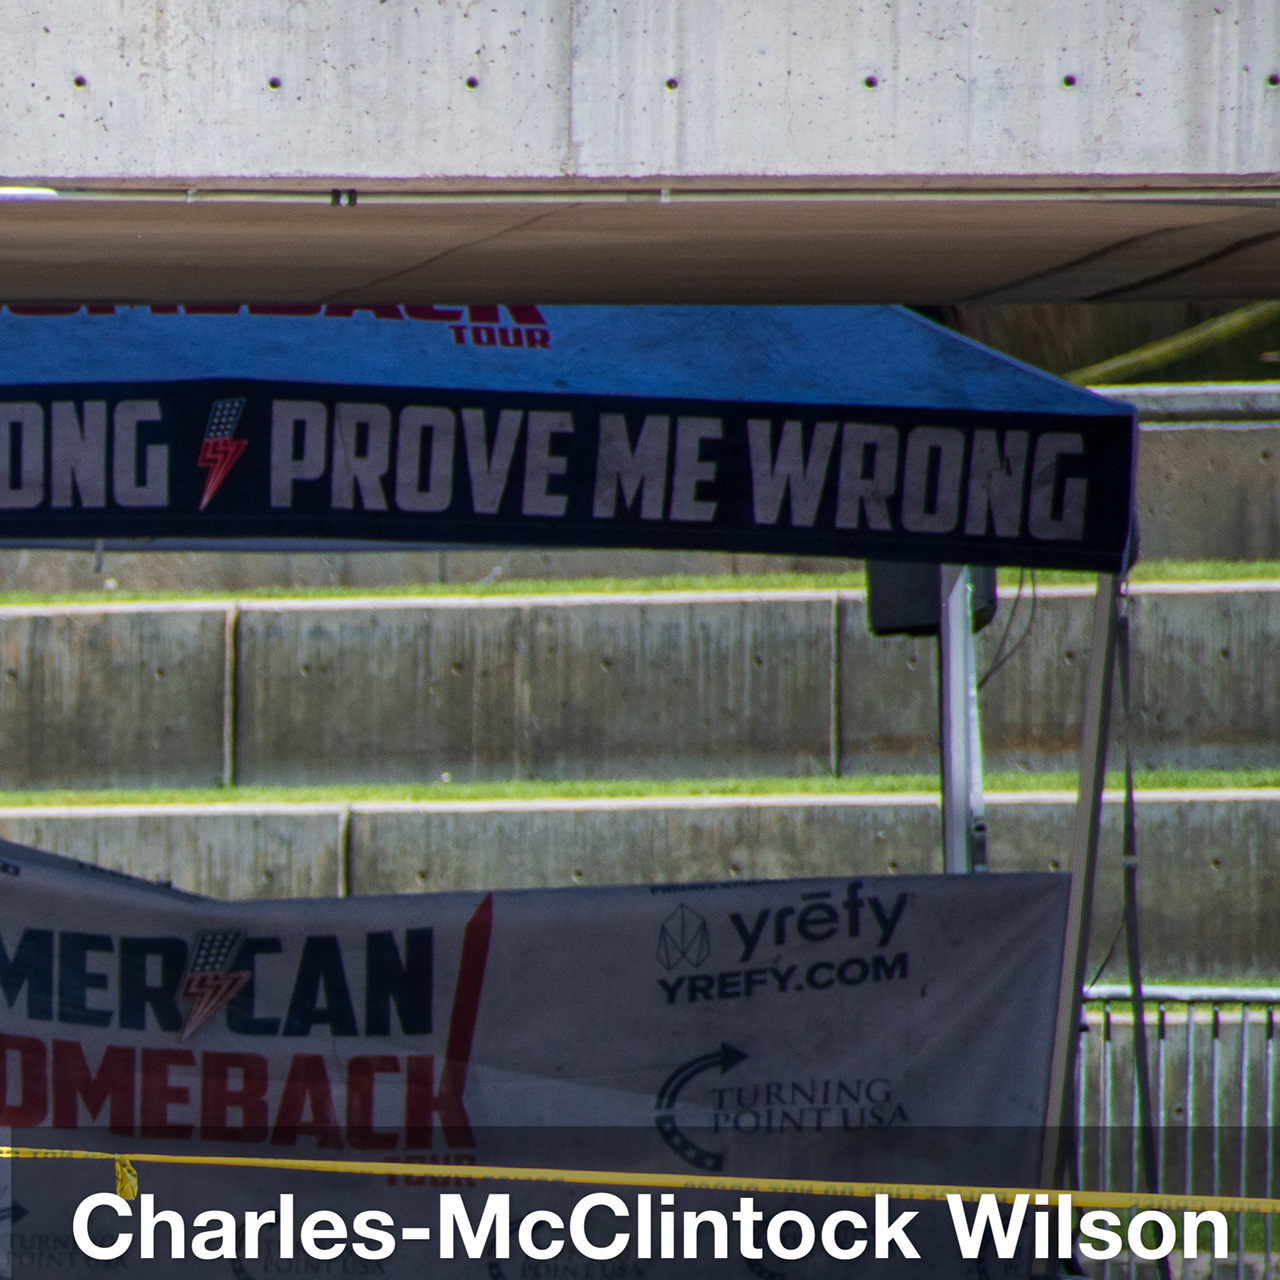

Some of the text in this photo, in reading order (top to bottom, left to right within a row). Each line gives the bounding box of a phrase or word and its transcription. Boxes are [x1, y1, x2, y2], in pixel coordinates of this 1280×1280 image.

[450, 325, 551, 350] TOUR
[270, 400, 574, 517] PROVE
[592, 413, 724, 522] ME
[747, 418, 1089, 541] WRONG
[656, 952, 910, 1005] YREFY.COM
[710, 1078, 893, 1111] TURNING
[711, 1106, 913, 1136] POINT USA
